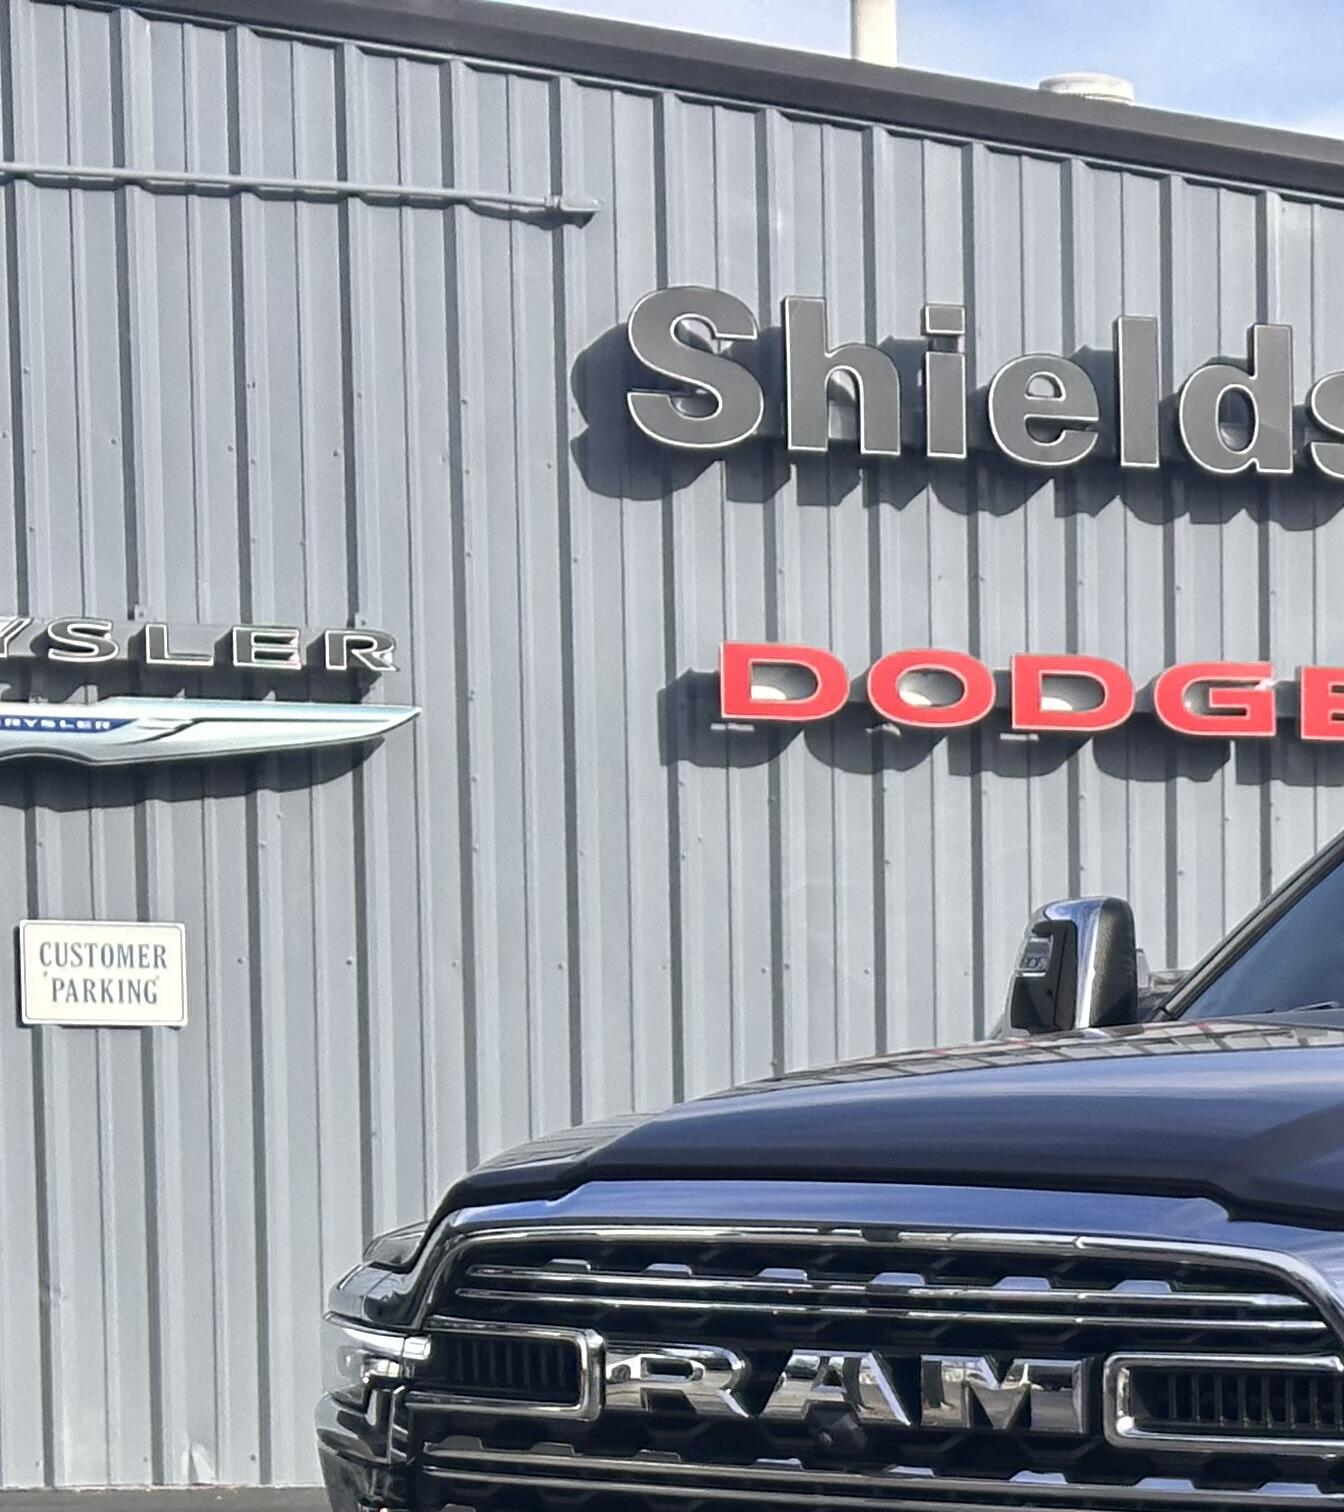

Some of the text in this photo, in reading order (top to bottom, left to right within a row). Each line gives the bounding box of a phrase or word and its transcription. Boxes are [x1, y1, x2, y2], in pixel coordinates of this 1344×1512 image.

[39, 941, 167, 969] CUSTOMER
[52, 977, 158, 1005] PARKING
[603, 1345, 1094, 1434] RAM
